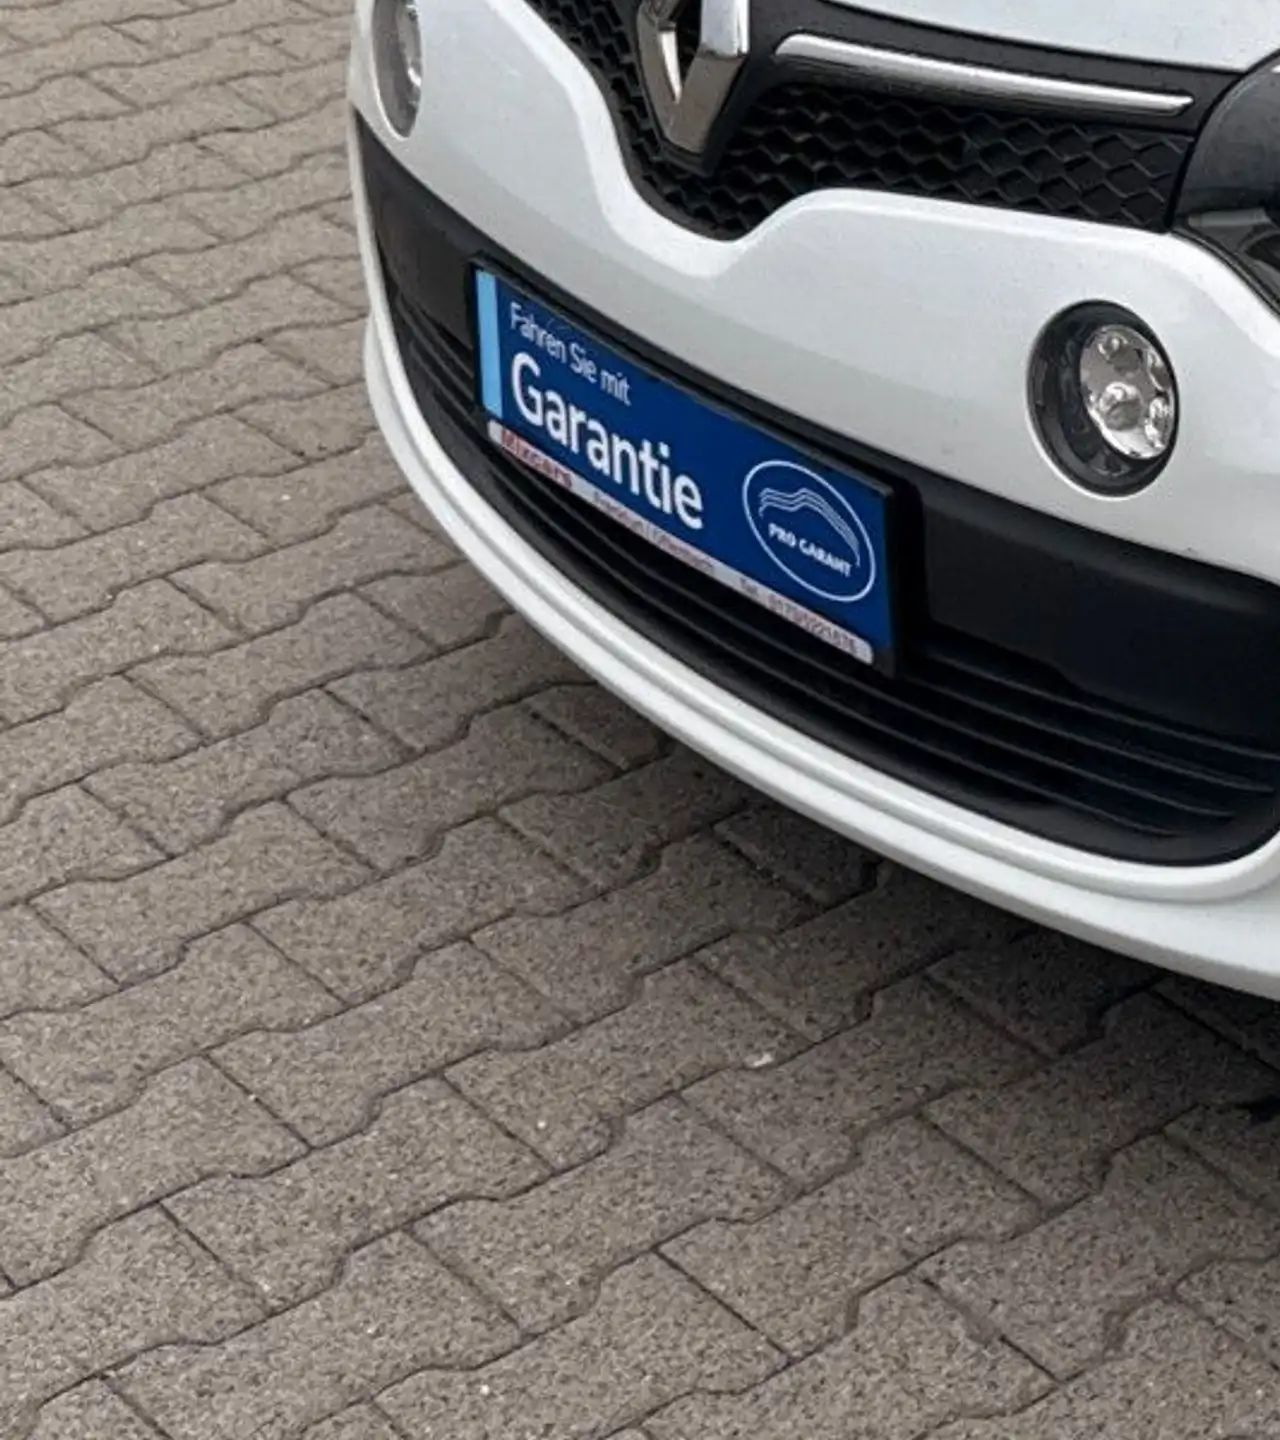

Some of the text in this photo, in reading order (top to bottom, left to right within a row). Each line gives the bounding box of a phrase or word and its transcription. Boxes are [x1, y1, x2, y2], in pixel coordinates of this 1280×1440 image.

[510, 300, 632, 406] Fahren Sie mit
[511, 351, 704, 530] Garantie
[768, 522, 852, 578] PRO GARANT
